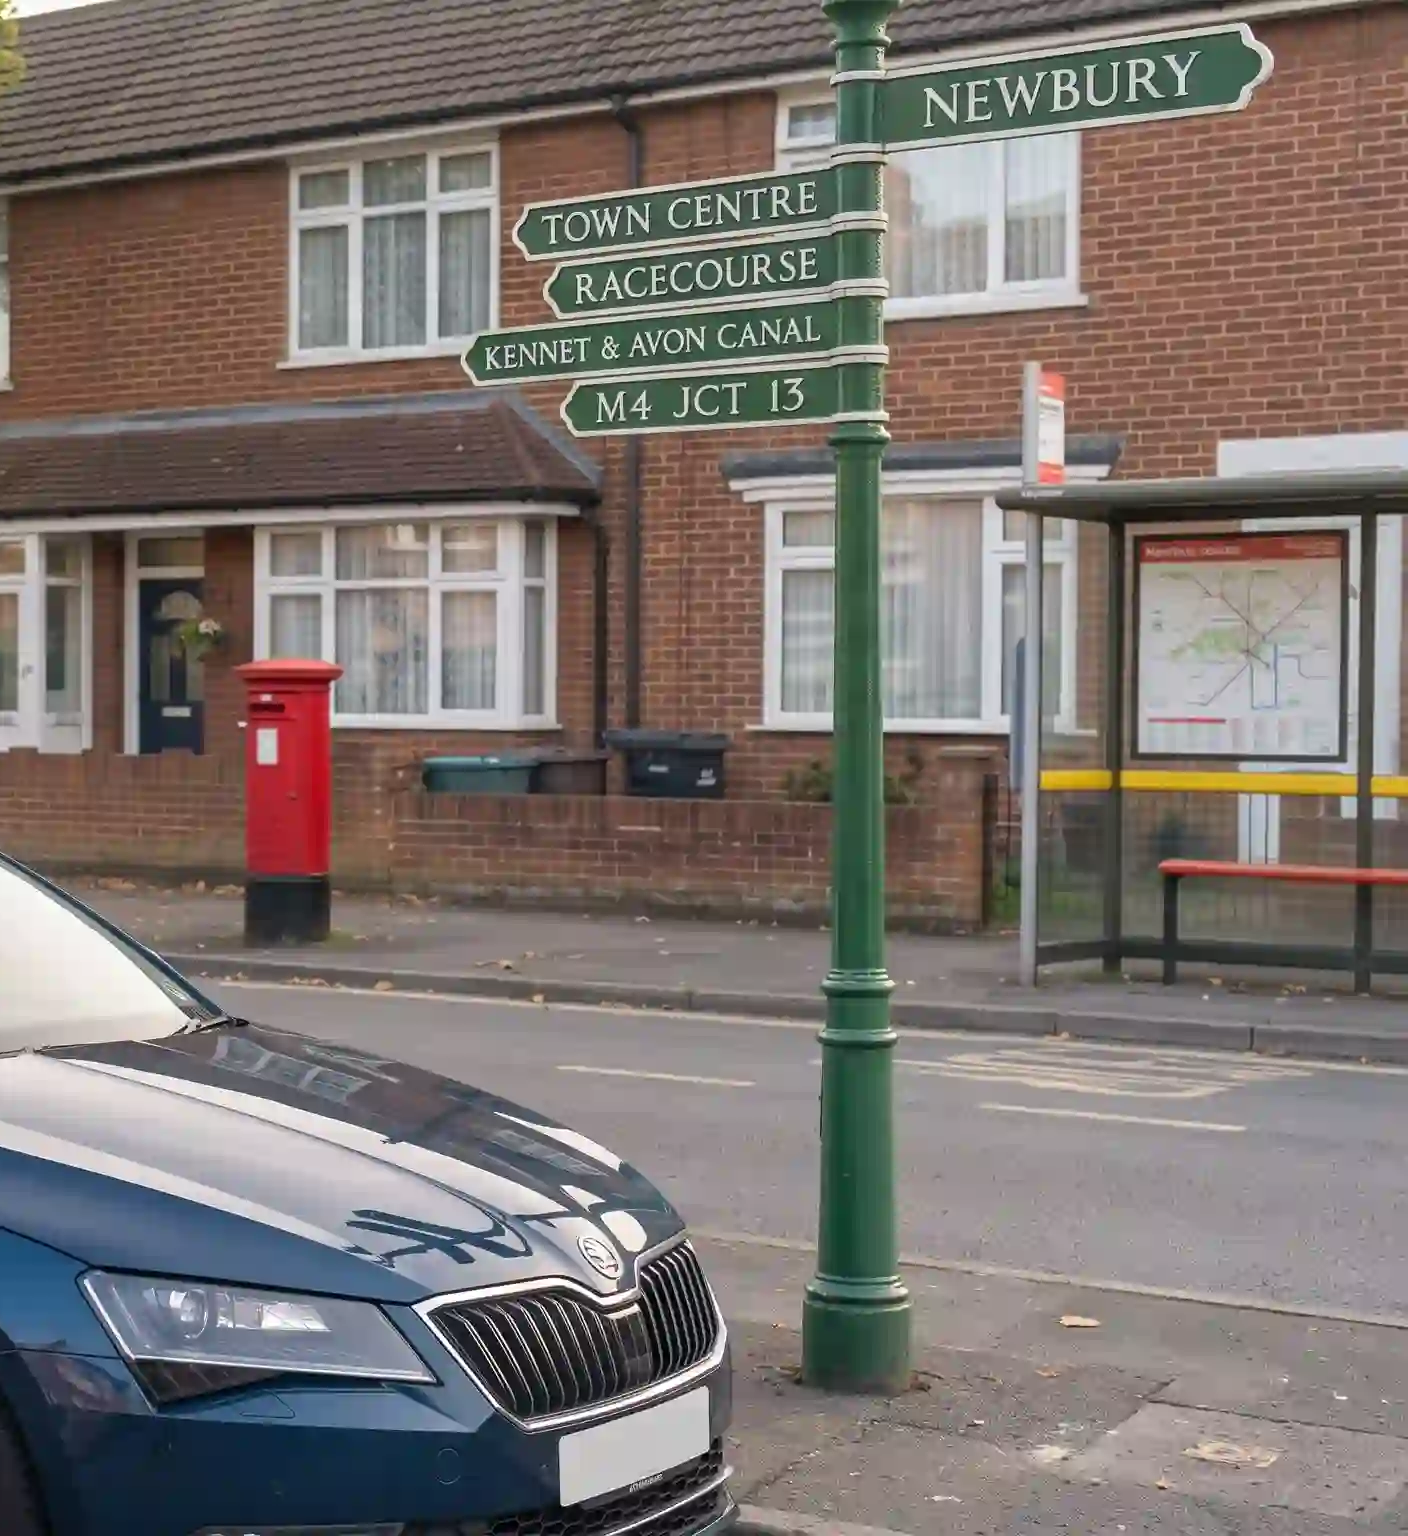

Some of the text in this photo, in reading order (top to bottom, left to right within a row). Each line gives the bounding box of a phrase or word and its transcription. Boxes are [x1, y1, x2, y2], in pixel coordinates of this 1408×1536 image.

[922, 50, 1203, 129] NEWBURY
[540, 181, 818, 245] TOWN CENTRE
[574, 247, 819, 306] RACECOURSE
[484, 316, 821, 371] KENNET & AVON CANAL
[595, 378, 804, 423] M4 JCT 13
